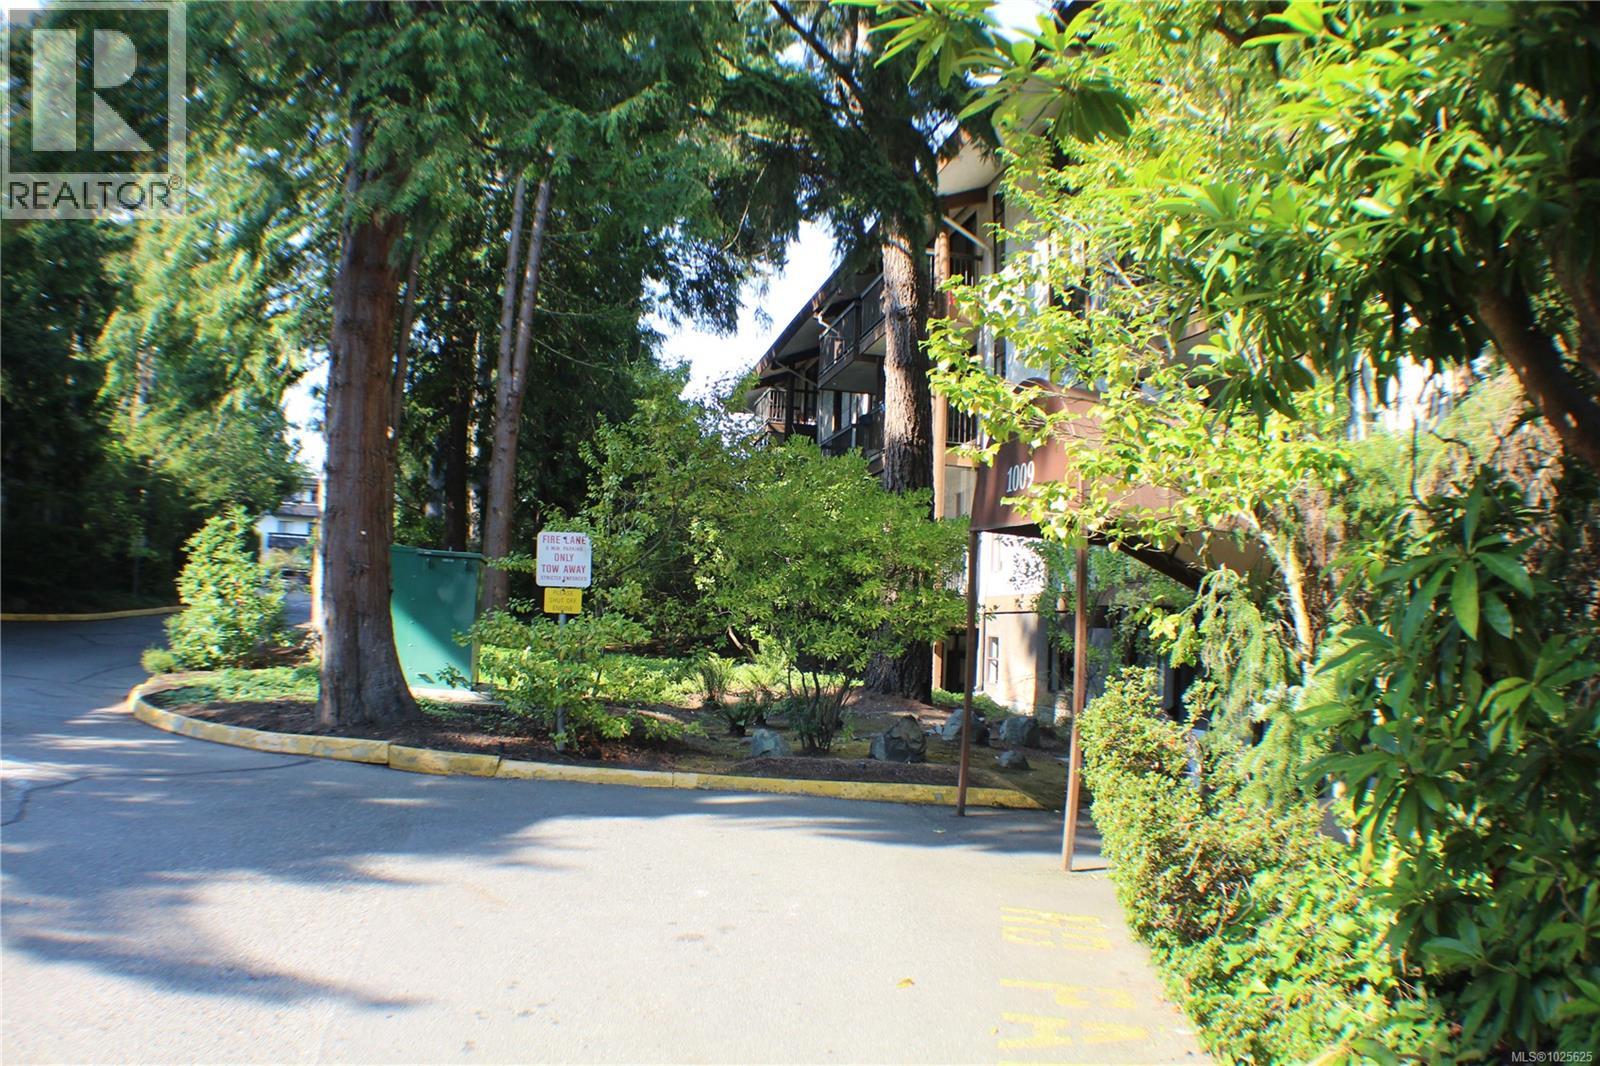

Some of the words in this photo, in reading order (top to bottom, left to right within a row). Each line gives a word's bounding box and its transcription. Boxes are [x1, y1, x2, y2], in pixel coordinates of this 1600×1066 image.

[1006, 460, 1035, 493] 1009
[542, 535, 560, 545] FIRE
[565, 536, 586, 545] LANE
[554, 553, 574, 562] ONLY
[542, 564, 559, 573] TOW
[563, 565, 586, 574] AWAY
